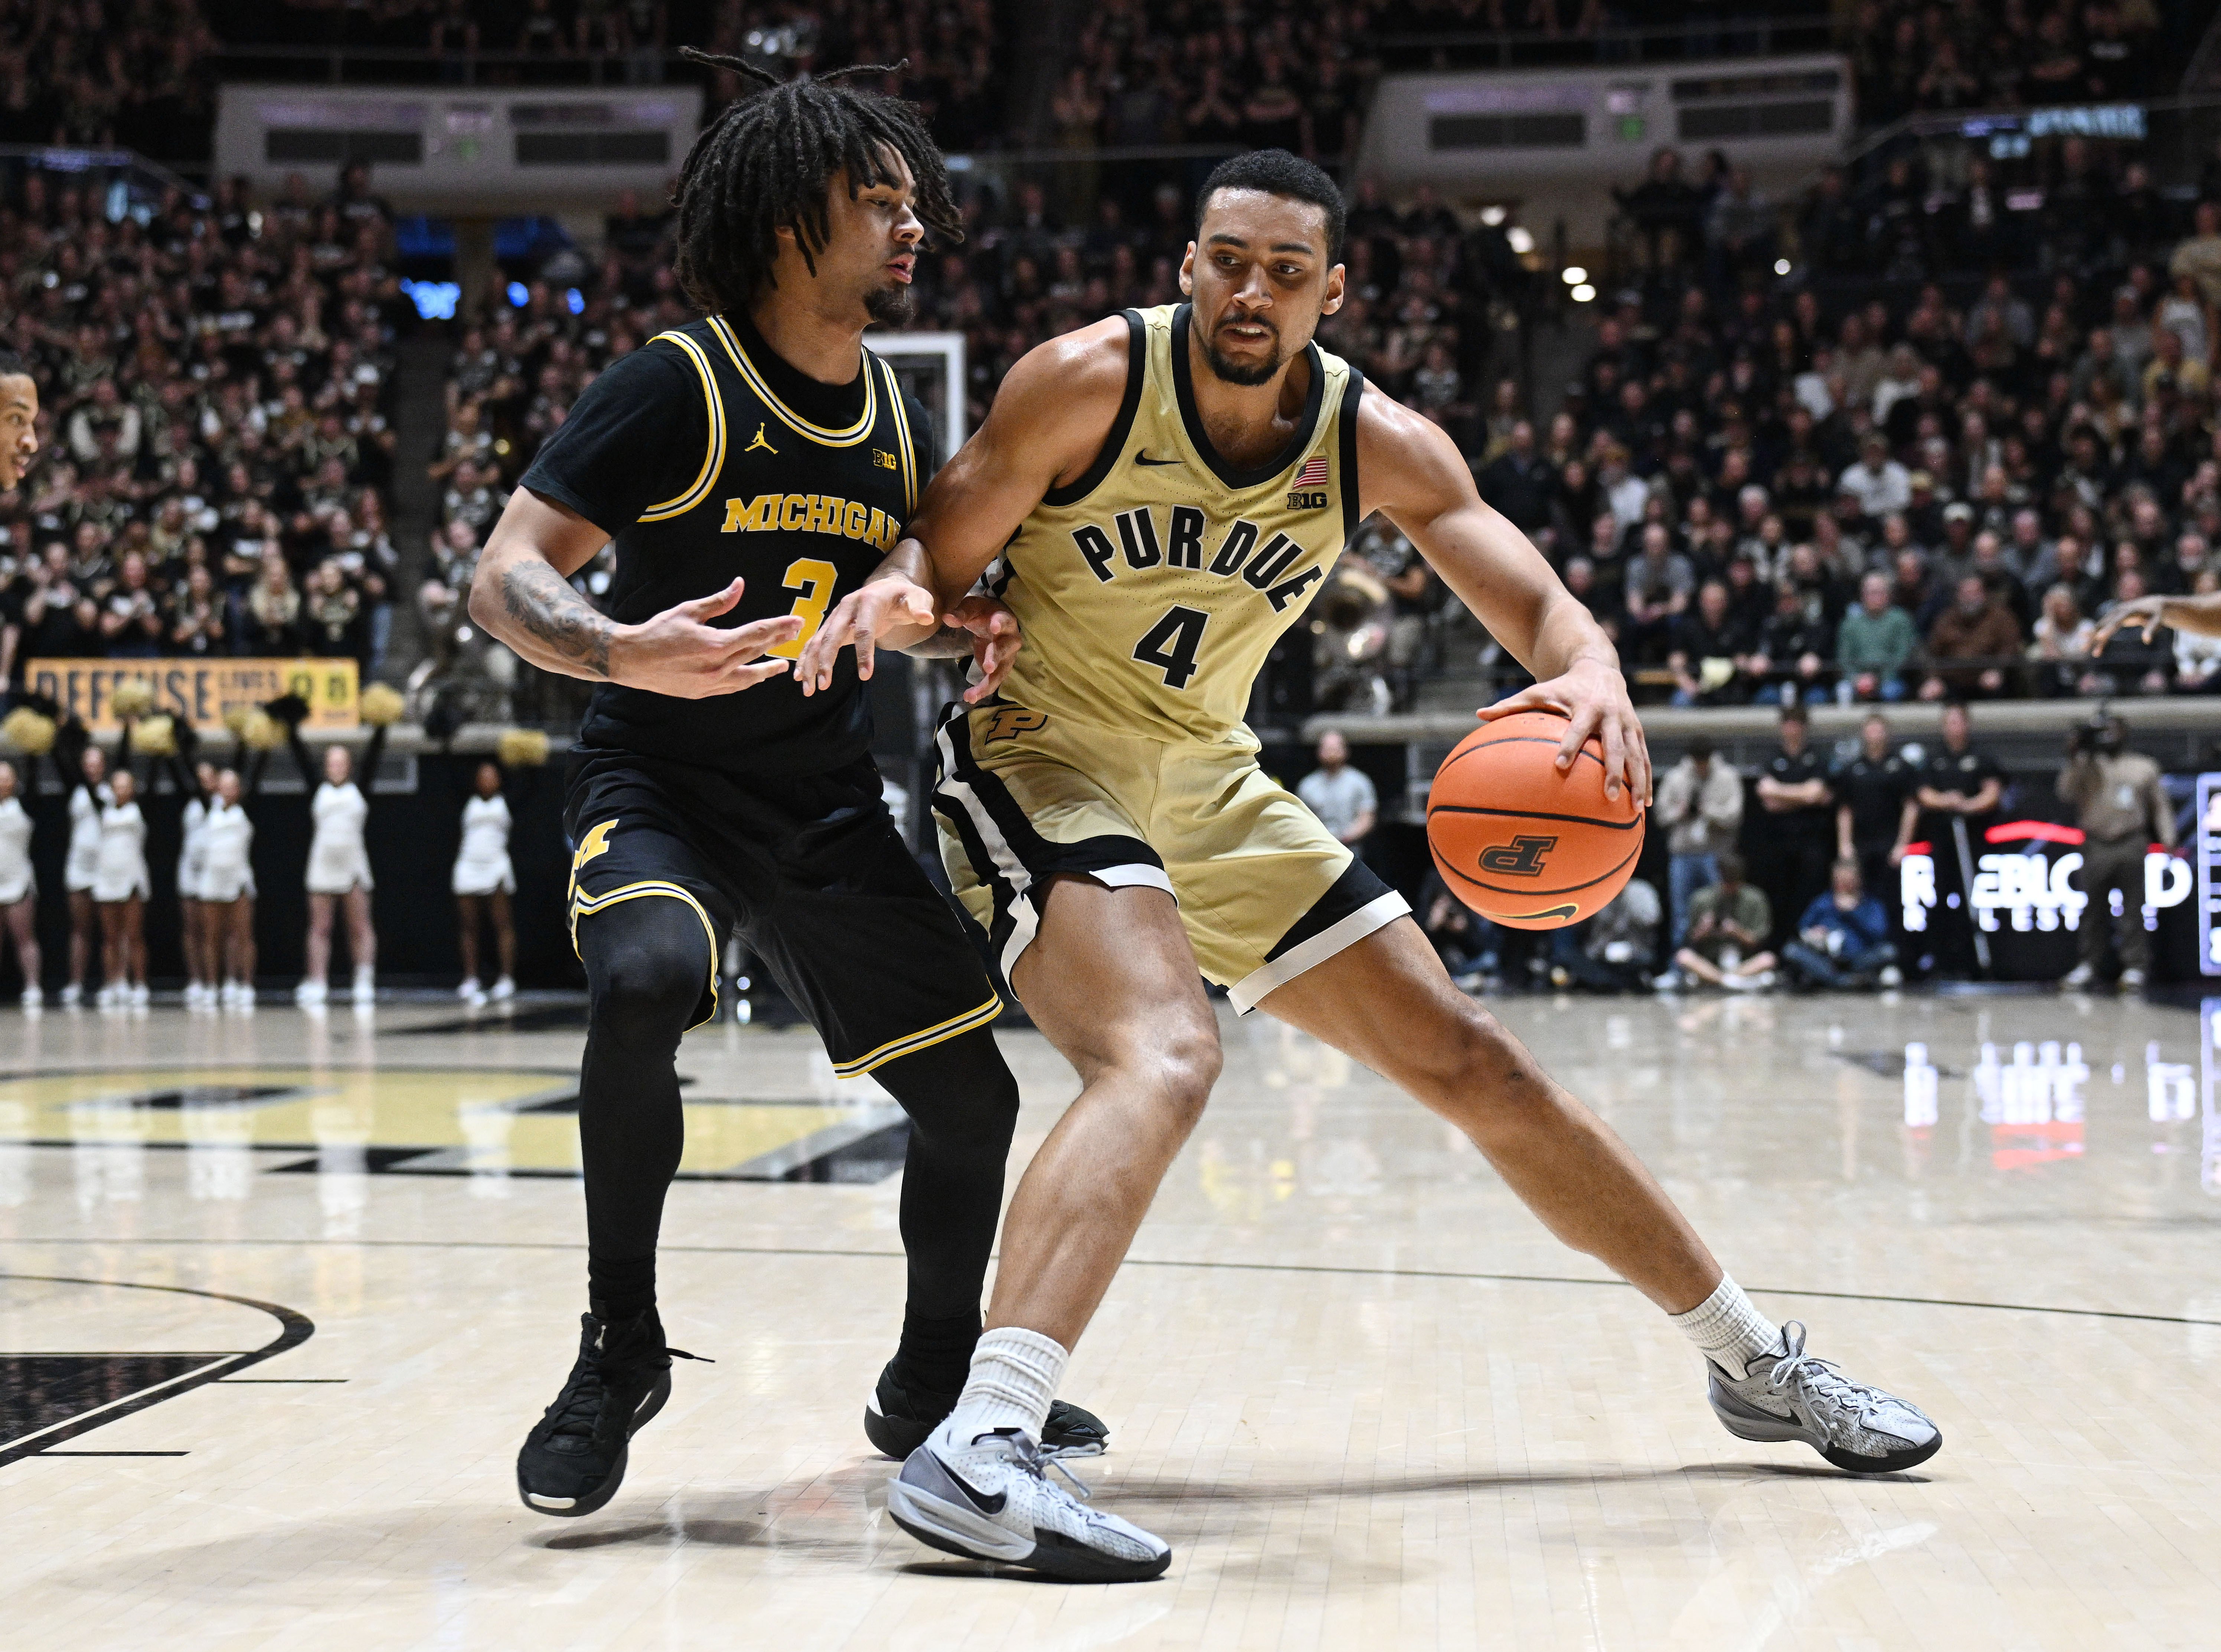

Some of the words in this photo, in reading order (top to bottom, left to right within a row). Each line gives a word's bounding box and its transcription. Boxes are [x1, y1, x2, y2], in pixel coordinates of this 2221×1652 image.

[1070, 504, 1325, 614] PURDUE
[765, 557, 838, 661] 3
[1131, 603, 1211, 690] 4
[984, 707, 1048, 745] P
[1478, 835, 1558, 876] P
